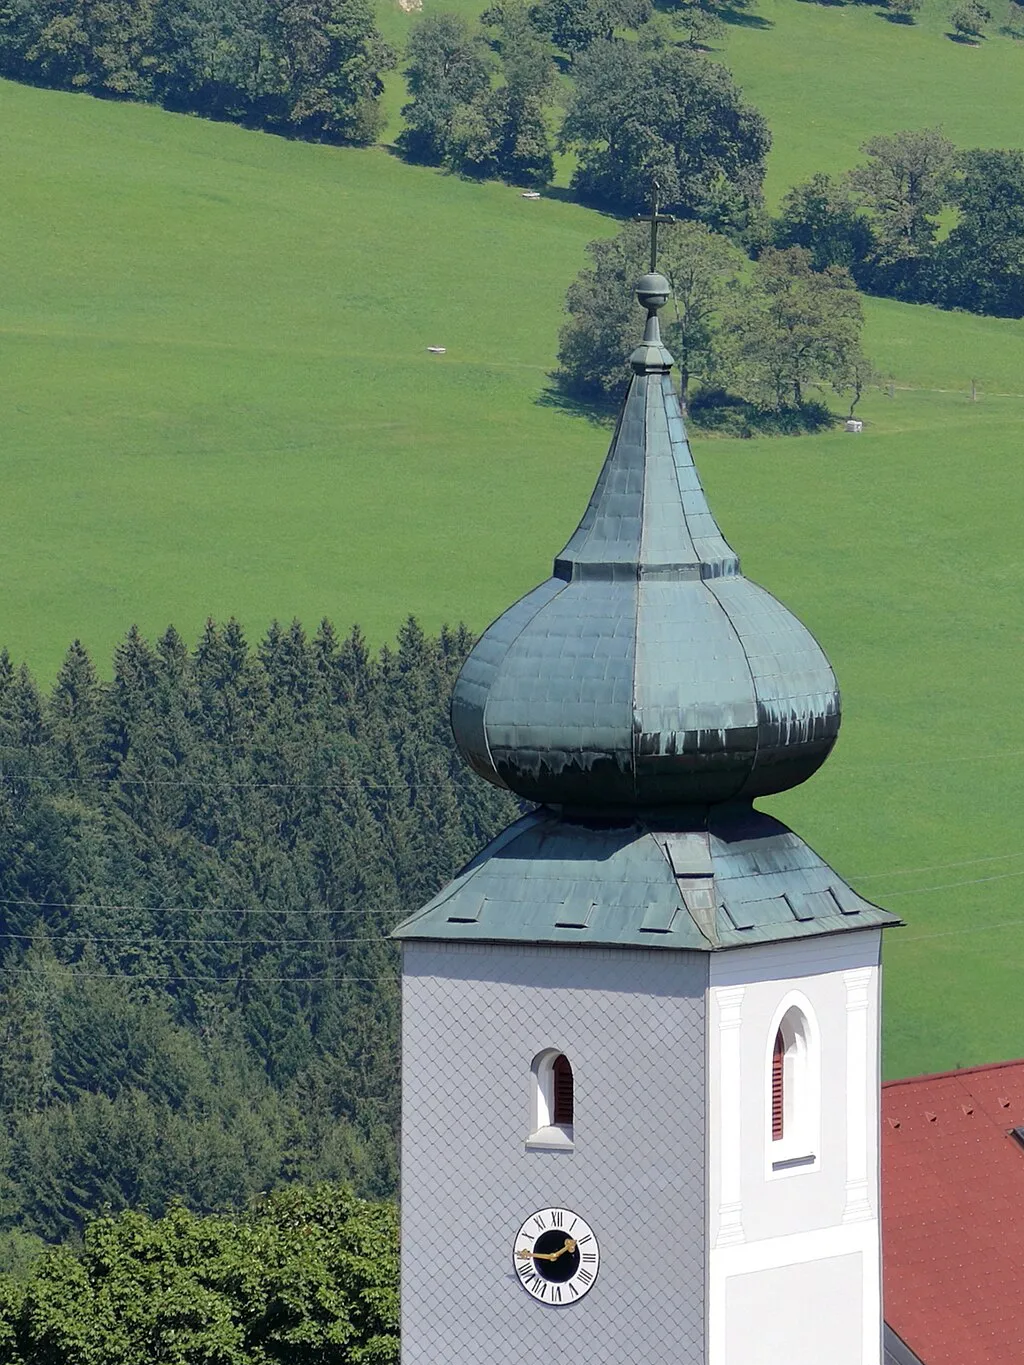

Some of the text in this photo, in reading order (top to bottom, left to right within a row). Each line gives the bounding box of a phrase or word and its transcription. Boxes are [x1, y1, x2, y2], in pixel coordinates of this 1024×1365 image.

[533, 1215, 546, 1232] XI
[551, 1211, 563, 1227] XII
[569, 1218, 577, 1232] I
[521, 1230, 535, 1242] X
[578, 1234, 592, 1245] II
[582, 1253, 596, 1263] III
[577, 1268, 594, 1286] IIII
